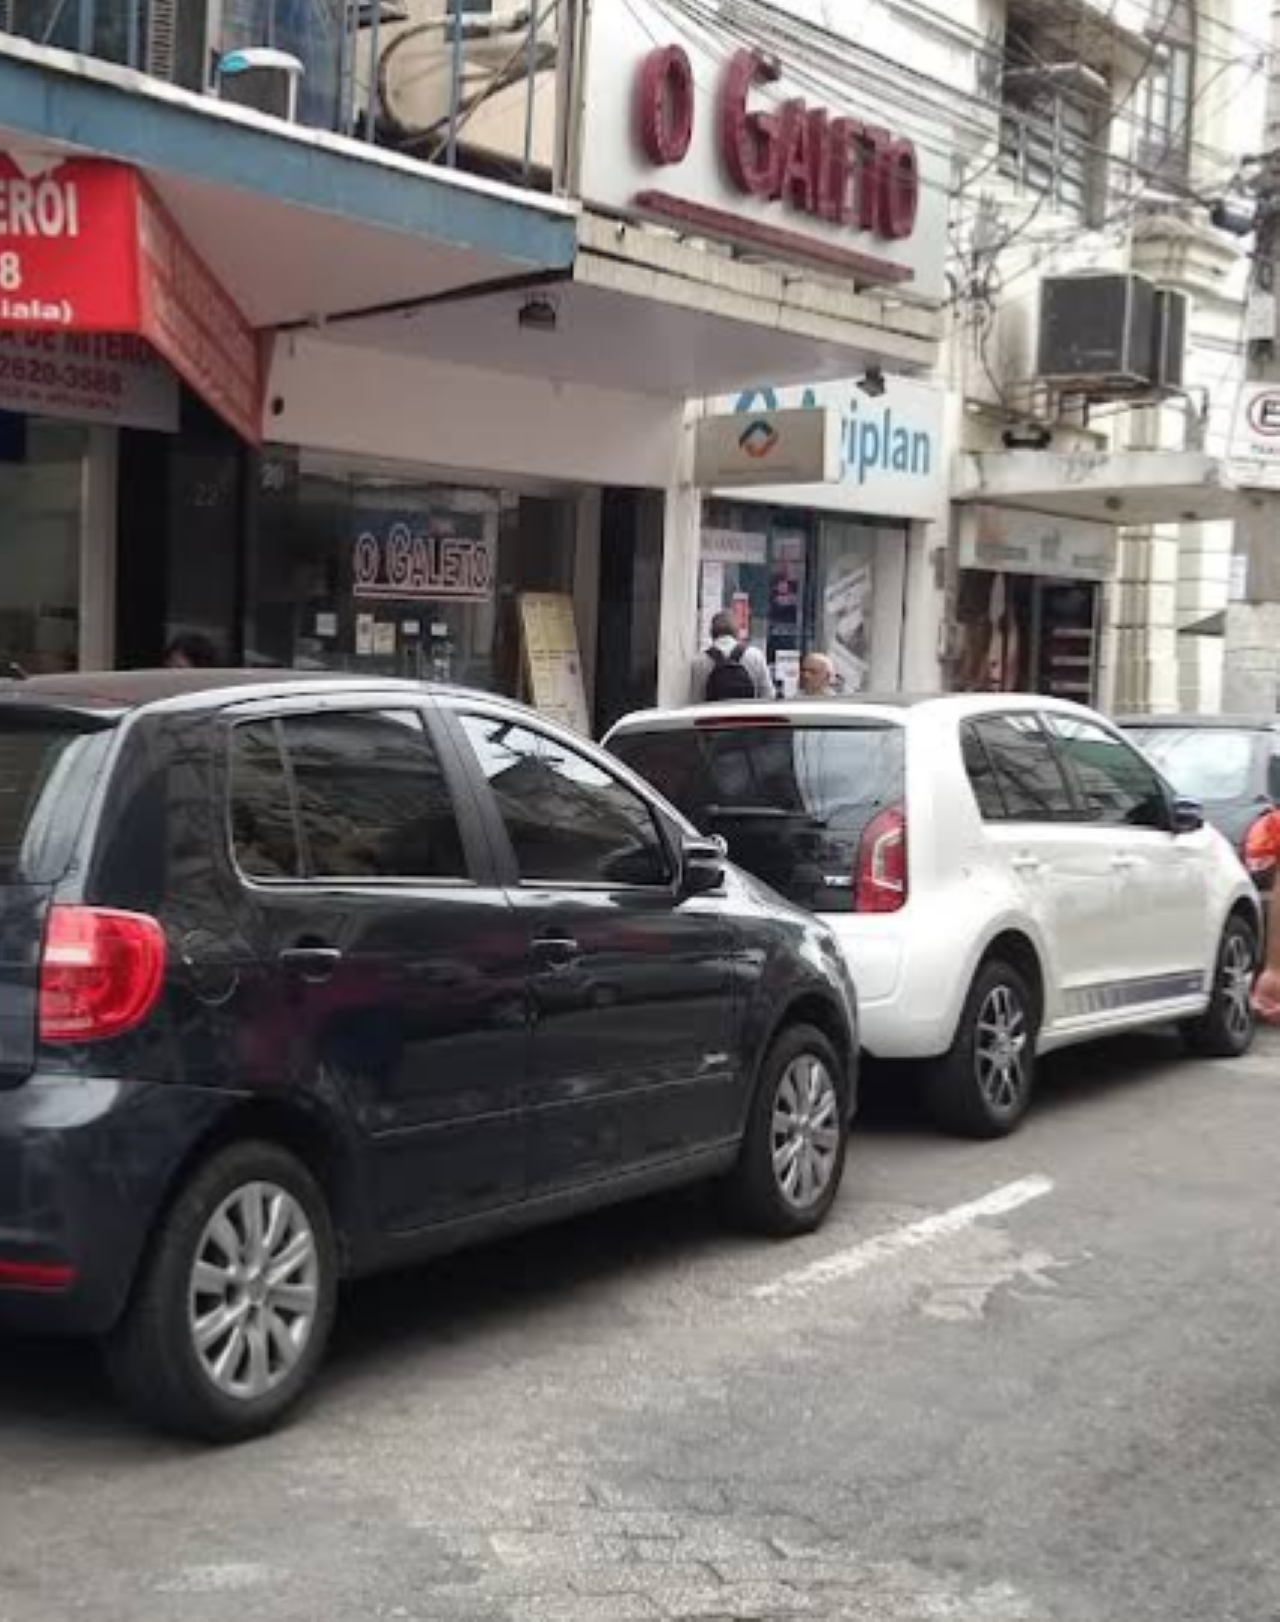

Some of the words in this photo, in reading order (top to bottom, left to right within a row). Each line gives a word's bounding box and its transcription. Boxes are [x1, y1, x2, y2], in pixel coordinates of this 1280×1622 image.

[635, 43, 694, 167] O
[354, 531, 379, 585] O
[386, 522, 491, 588] GALETO
